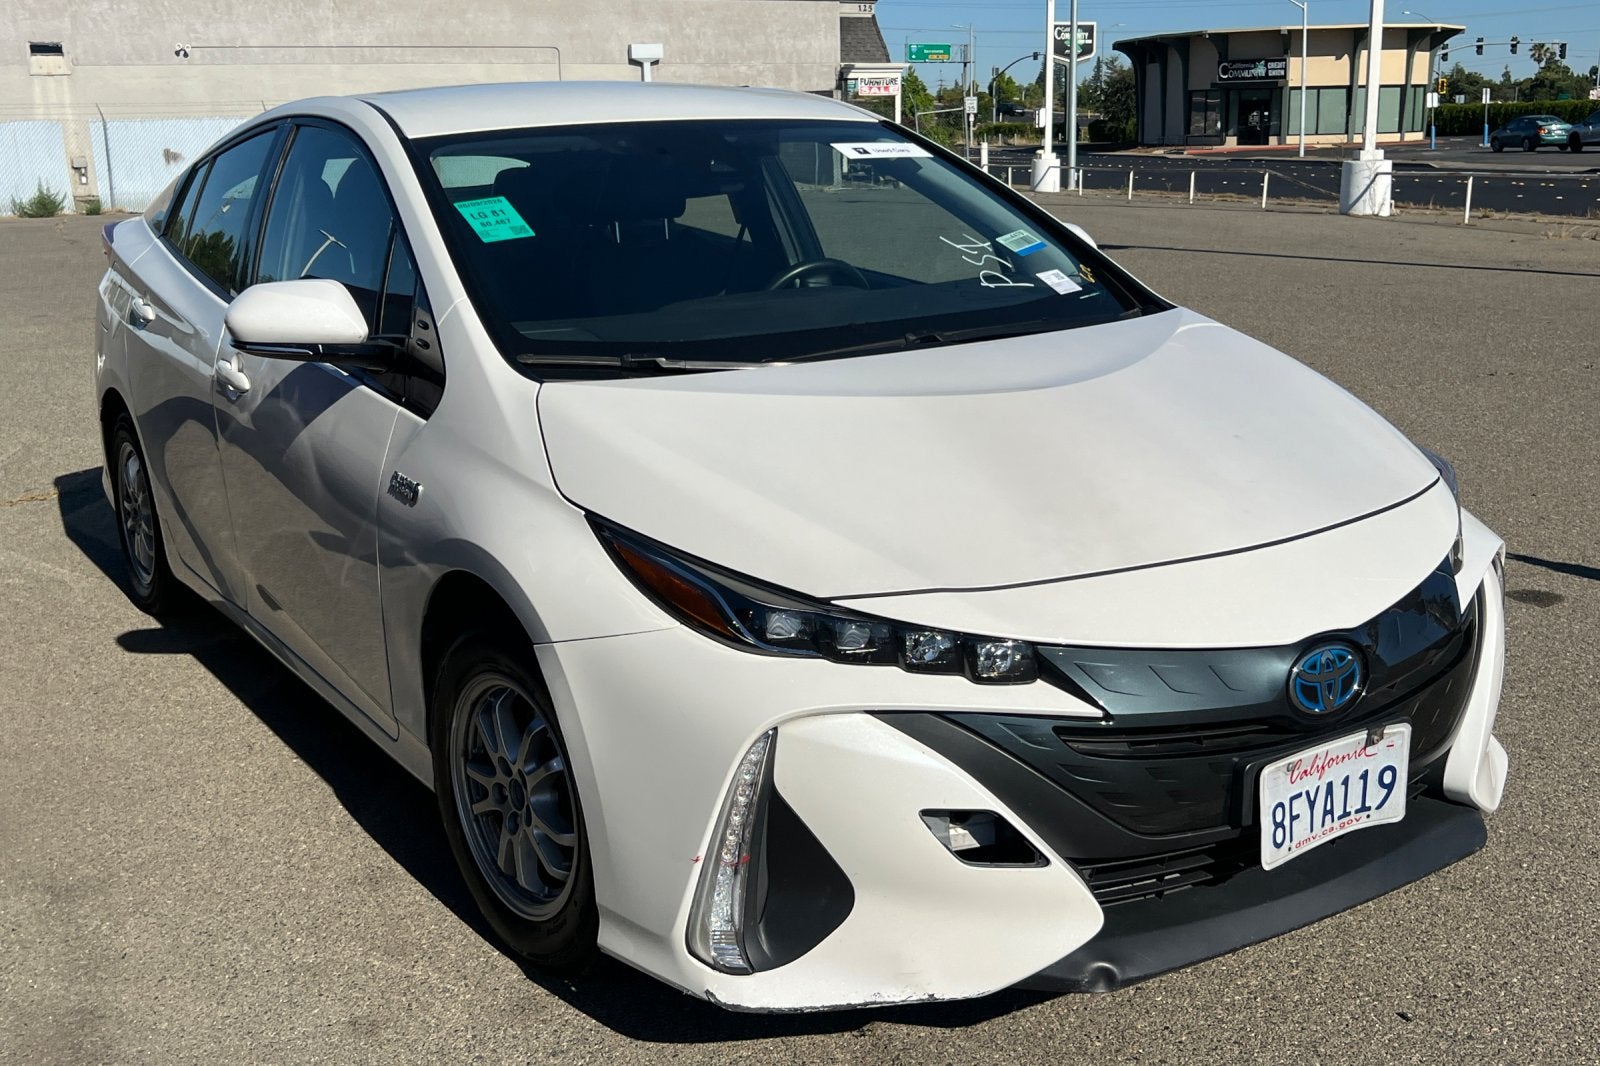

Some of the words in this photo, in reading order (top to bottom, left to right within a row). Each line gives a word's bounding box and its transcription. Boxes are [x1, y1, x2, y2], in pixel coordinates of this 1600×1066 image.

[1267, 61, 1286, 69] CREDIT
[860, 77, 899, 86] FURNITURE
[860, 86, 899, 94] SALE
[470, 211, 488, 220] LG
[1290, 745, 1378, 785] California
[1271, 764, 1397, 849] 8FYA119
[1295, 815, 1363, 849] dmv.ca.gov
